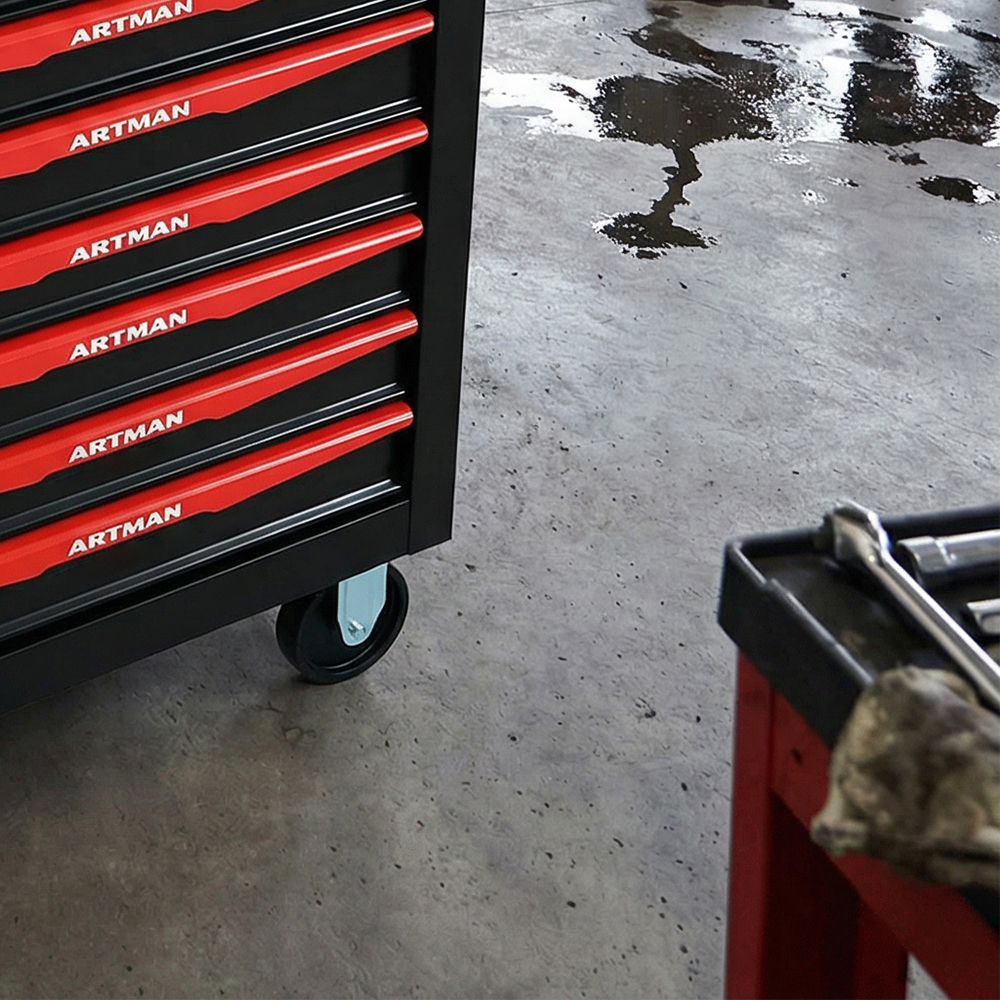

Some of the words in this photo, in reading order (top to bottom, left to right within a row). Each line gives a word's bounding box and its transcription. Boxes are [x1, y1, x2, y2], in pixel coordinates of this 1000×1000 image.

[69, 100, 191, 152] ARTMAN
[69, 213, 189, 265] ARTMAN
[68, 309, 188, 362] ARTMAN
[68, 410, 184, 463] ARTMAN
[67, 503, 182, 557] ARTMAN
